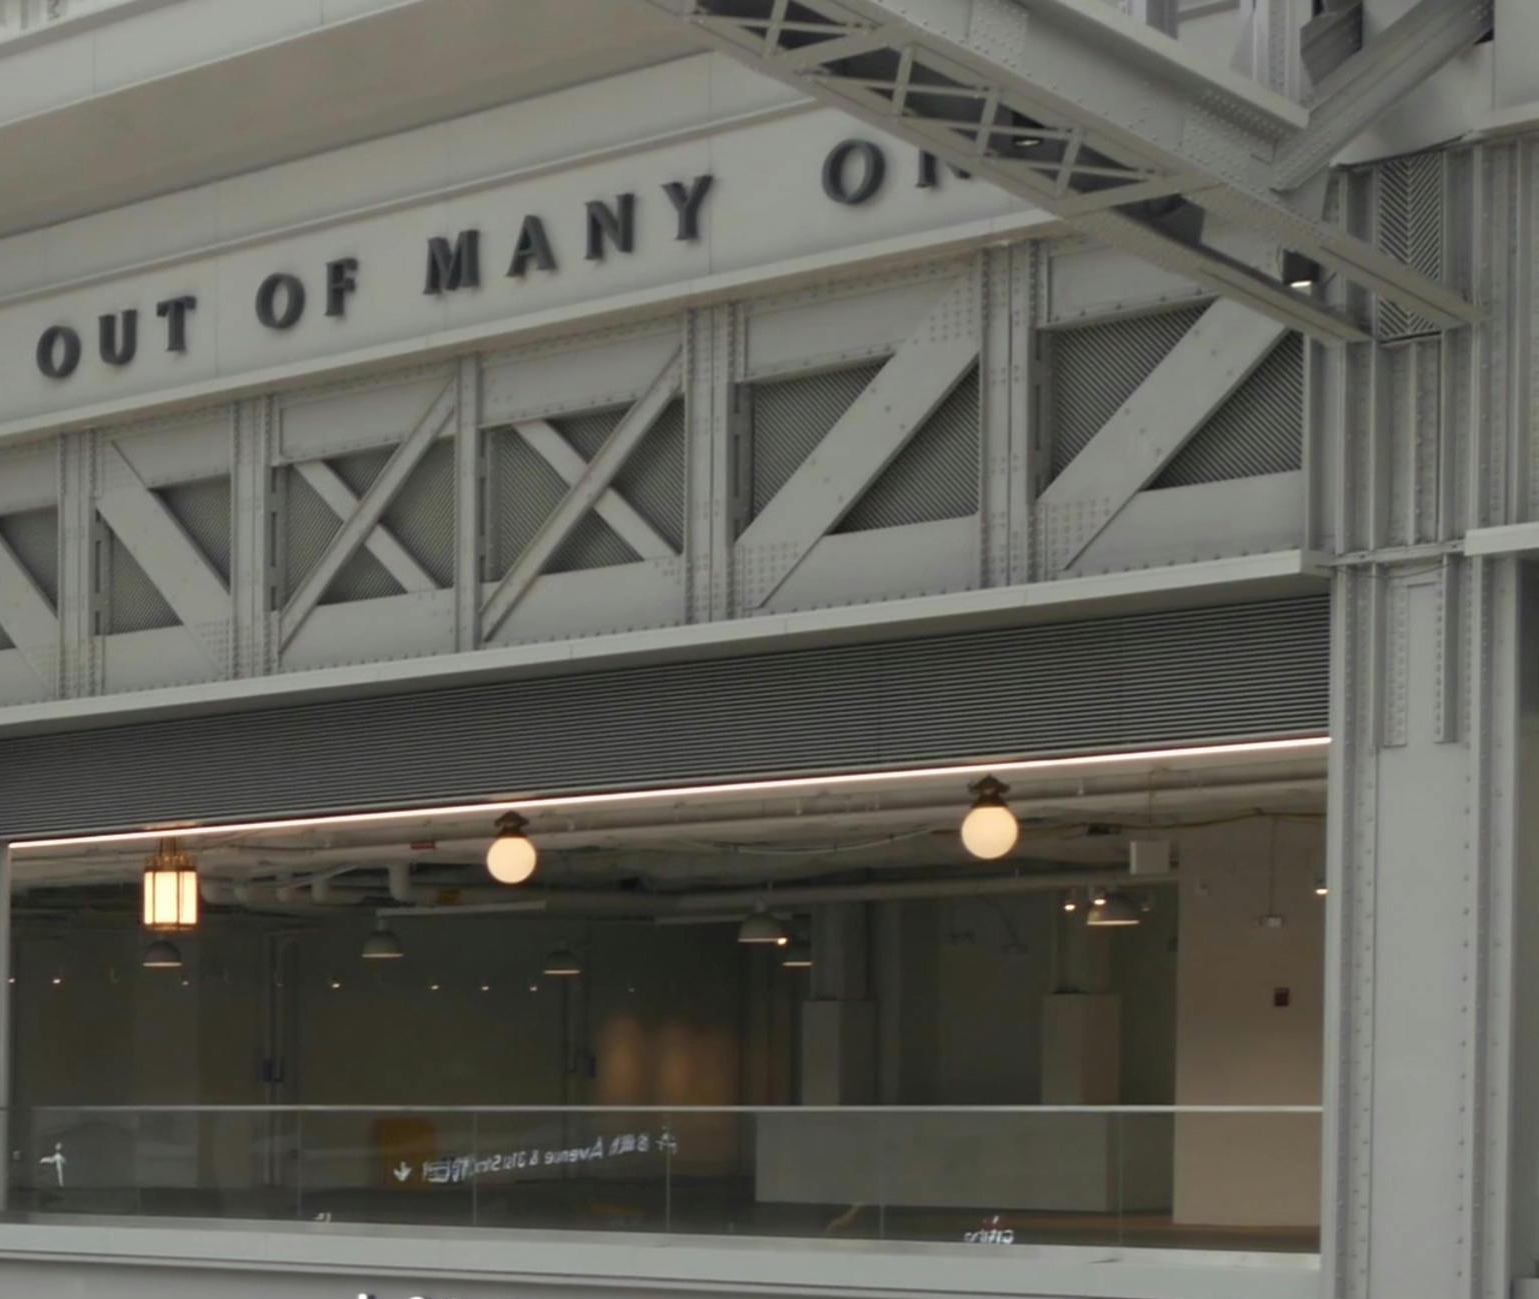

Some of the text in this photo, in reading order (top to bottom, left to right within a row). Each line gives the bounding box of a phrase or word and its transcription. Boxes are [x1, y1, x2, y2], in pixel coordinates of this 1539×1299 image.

[37, 296, 196, 379] OUT
[257, 258, 358, 330] OF
[425, 175, 713, 295] MANY
